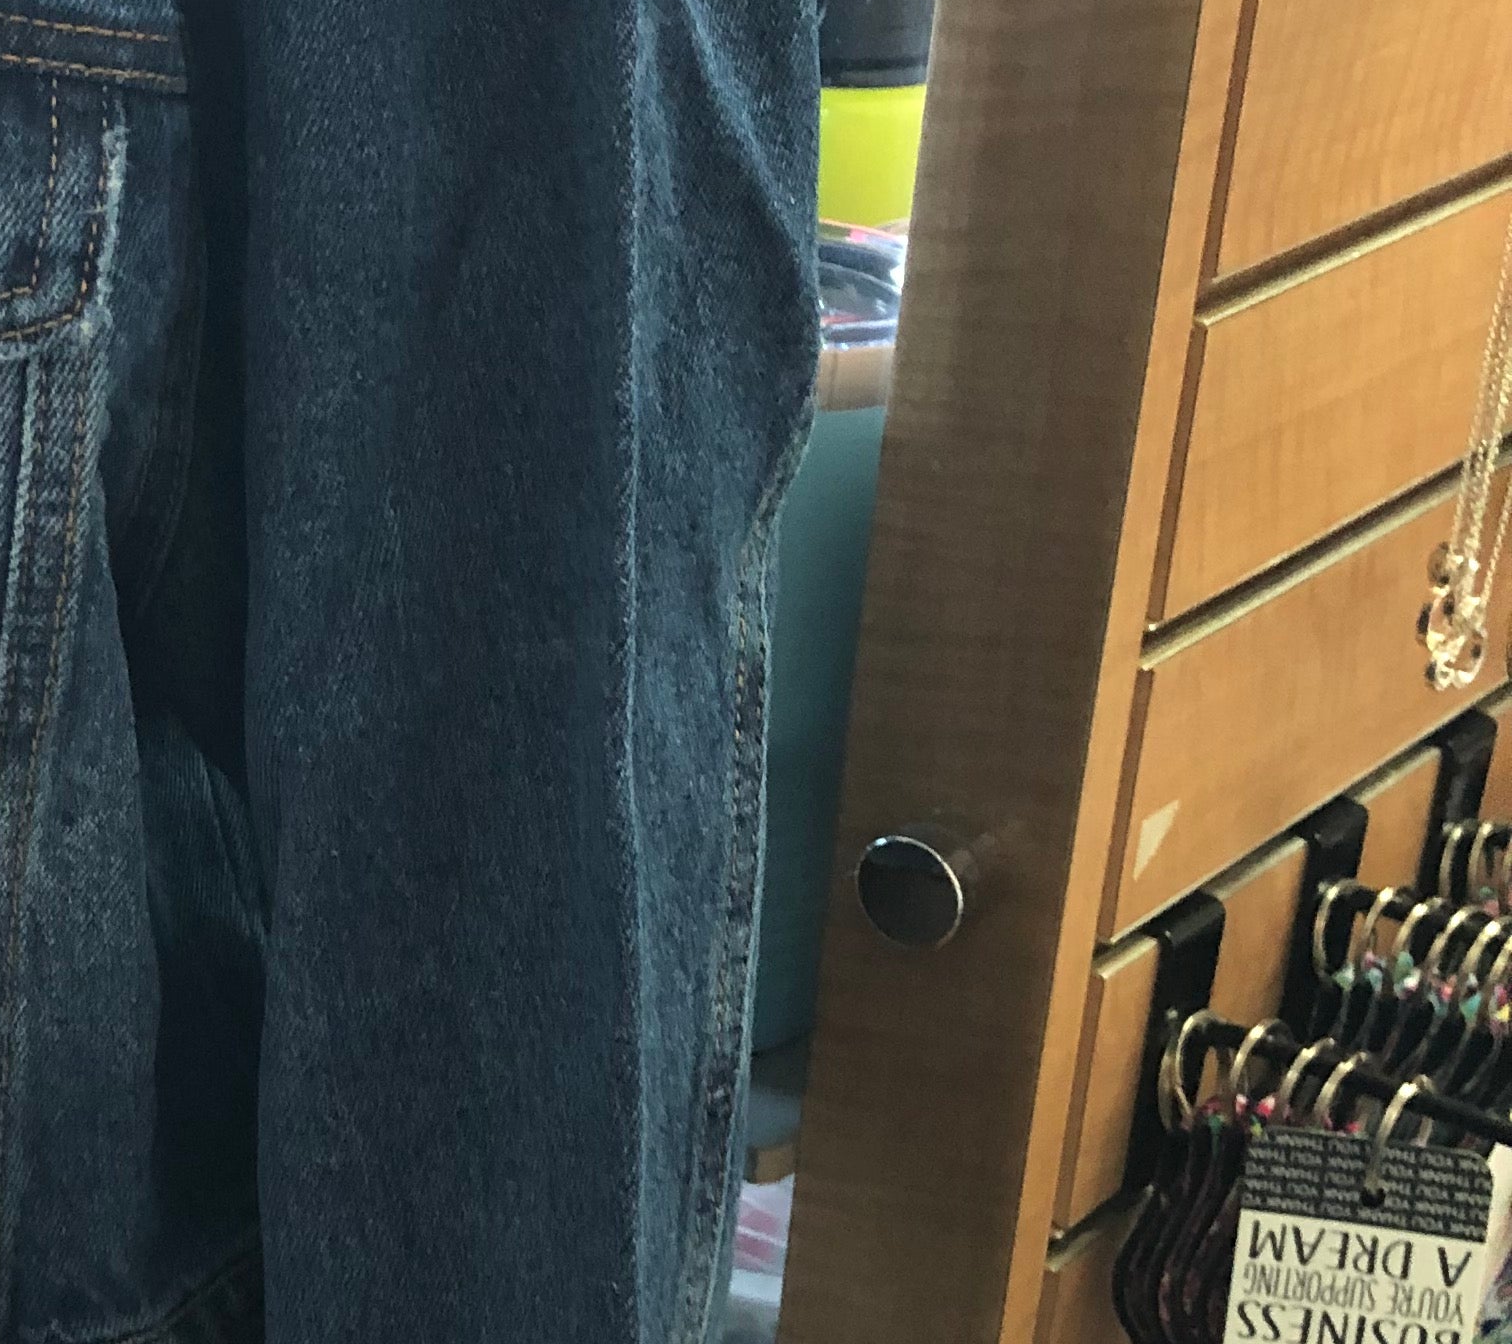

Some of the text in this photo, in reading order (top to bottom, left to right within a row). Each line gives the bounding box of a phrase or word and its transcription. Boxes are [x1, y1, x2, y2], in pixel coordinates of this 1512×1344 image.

[1250, 1220, 1472, 1287] A DREAM
[1244, 1263, 1463, 1326] YOU'RE SUPPORTING
